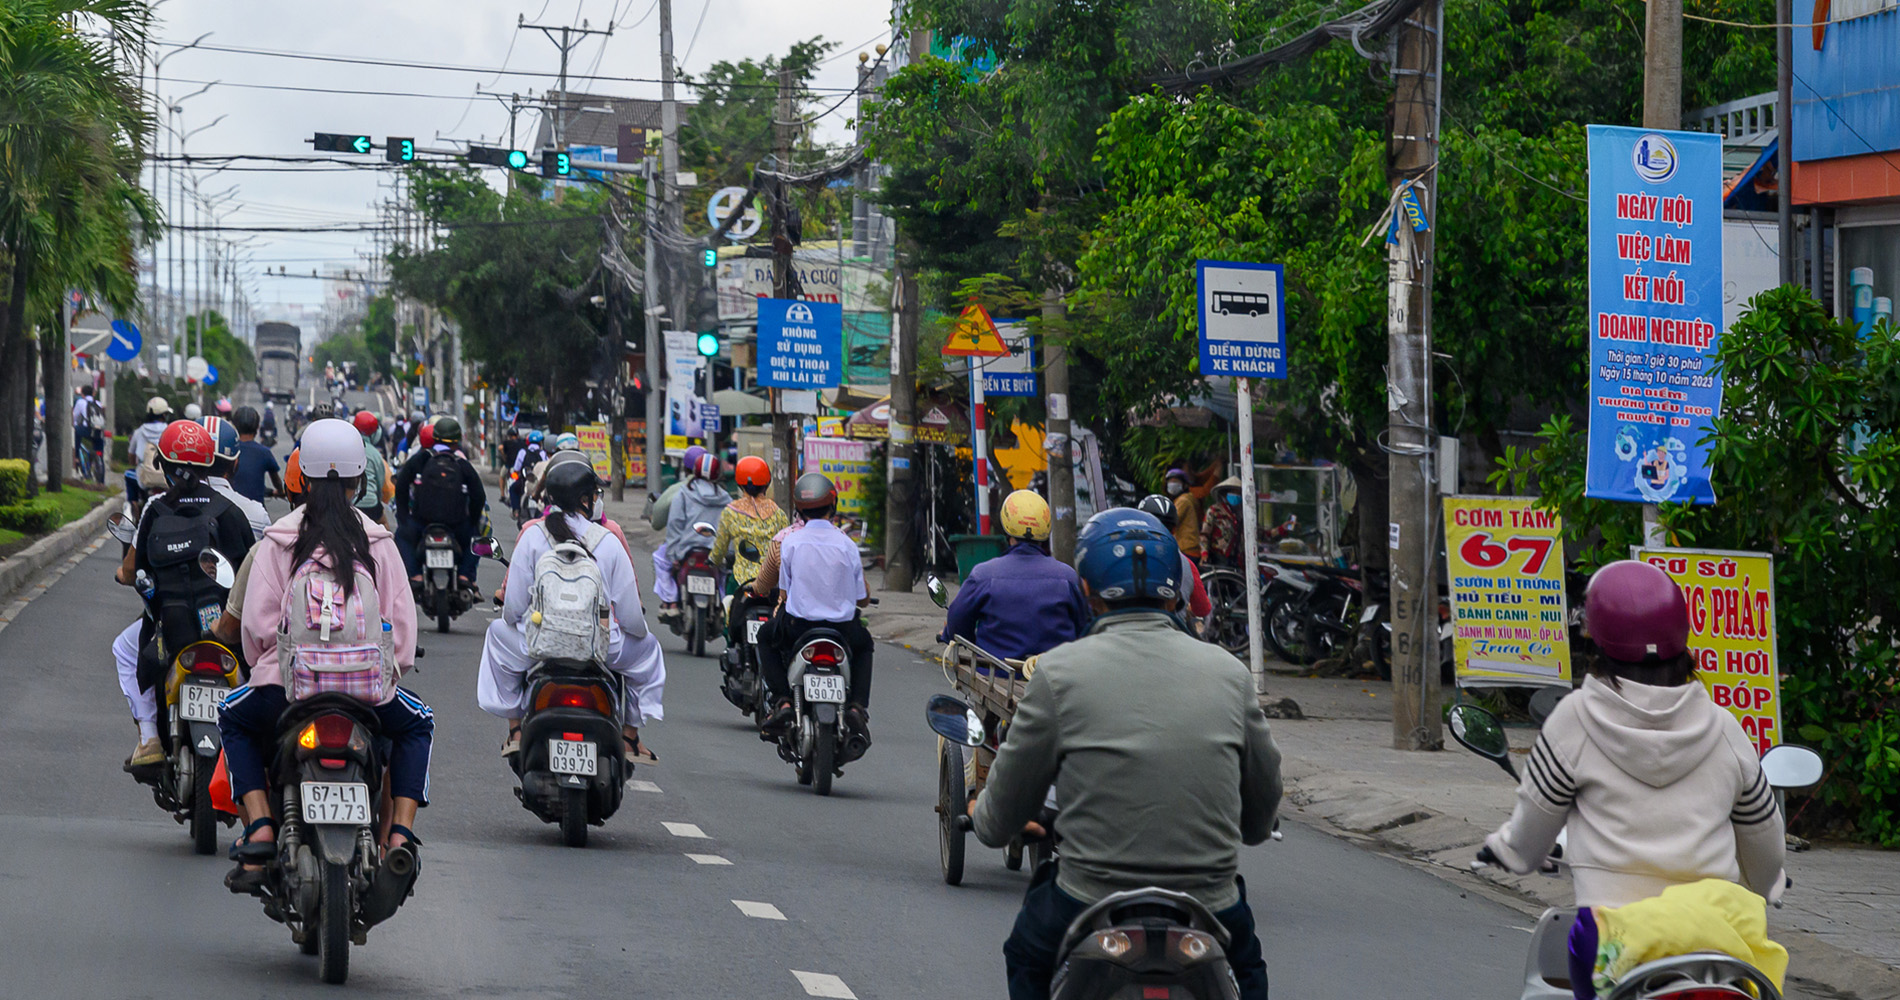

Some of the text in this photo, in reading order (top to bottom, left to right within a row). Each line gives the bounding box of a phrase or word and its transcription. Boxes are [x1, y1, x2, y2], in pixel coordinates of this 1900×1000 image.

[402, 140, 413, 160] 3
[558, 154, 569, 174] 3
[1617, 192, 1693, 228] NGÀY HỘI
[1617, 231, 1691, 265] VIỆC LÀM
[705, 250, 716, 266] 3
[1624, 268, 1684, 304] KẾT NỐI
[782, 326, 817, 339] KHÔNG
[1598, 313, 1715, 352] DOANH NGHIỆP
[777, 339, 822, 356] SỬ DỤNG
[1209, 341, 1281, 359] ĐIỂM DỪNG
[770, 355, 830, 373] ĐIỆN THOẠI
[1213, 358, 1275, 373] XE KHÁCH
[1608, 350, 1624, 363] Thời
[1644, 354, 1649, 365] 7
[1650, 356, 1665, 369] giờ
[1667, 356, 1679, 368] 30
[1680, 358, 1702, 371] phút
[772, 370, 826, 384] KHI LÁI XE
[1001, 378, 1011, 392] XE
[1600, 366, 1713, 388] Ngày 15 tháng 10 năm 2023
[1598, 396, 1713, 417] TRƯỜNG TIỂU HỌC
[1670, 417, 1691, 426] DU
[1455, 508, 1503, 528] CƠM
[1459, 532, 1555, 576] 67
[1648, 557, 1737, 578] CƠ SỞ
[1455, 576, 1561, 590] SƯỜN BÌ TRỨNG
[1456, 591, 1479, 603] HỦ
[1485, 591, 1522, 604] TIẾU
[1540, 594, 1561, 605] MÌ
[1458, 607, 1491, 620] BÁNH
[1495, 609, 1528, 621] CANH
[1540, 611, 1561, 622] NUI
[1710, 574, 1770, 641] PHÁT
[1458, 624, 1482, 639] BÁNH
[1484, 626, 1495, 639] MÌ
[1515, 628, 1531, 642] MẠI
[1553, 629, 1563, 641] LA
[1725, 649, 1770, 676] HƠI
[810, 677, 837, 688] 67-B1
[808, 689, 842, 700] 490.70
[1712, 680, 1772, 711] BÓP
[557, 742, 588, 757] 67-B1
[553, 756, 594, 773] 039.79
[312, 786, 356, 802] 67-L1
[308, 804, 366, 820] 617.73
